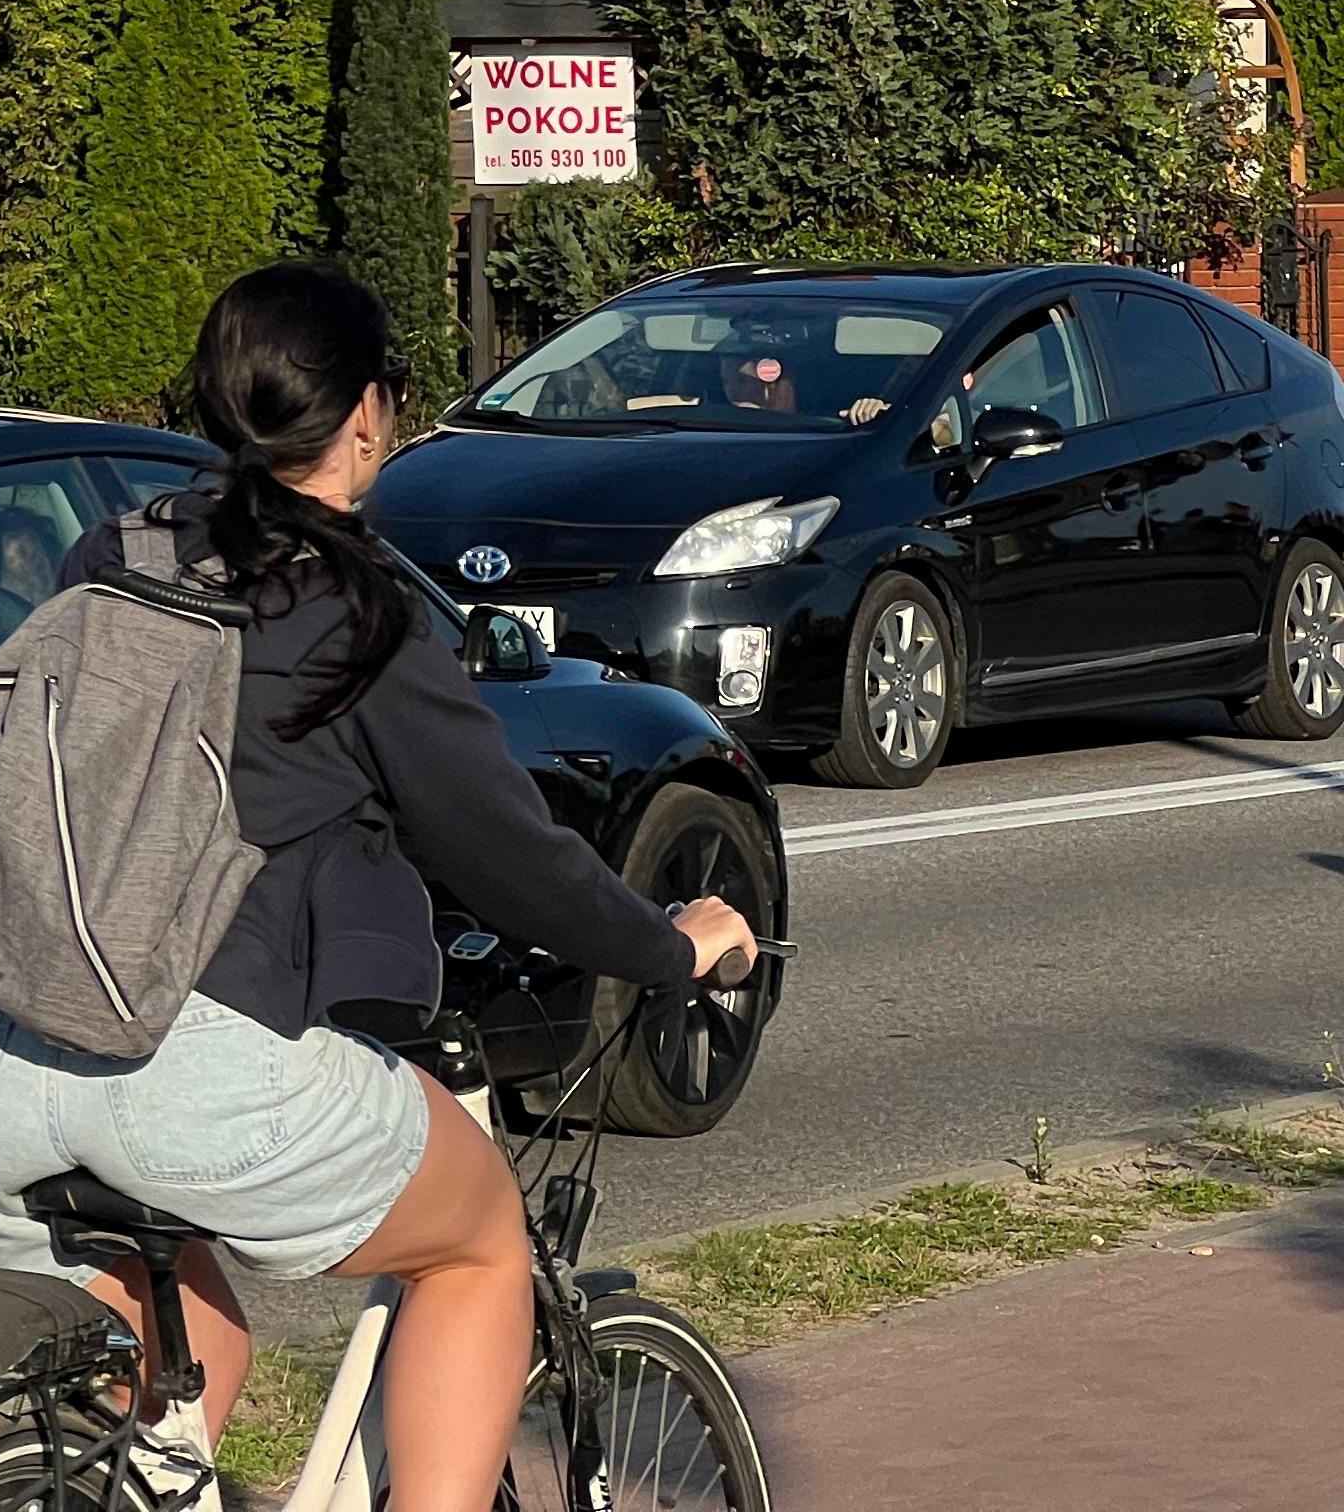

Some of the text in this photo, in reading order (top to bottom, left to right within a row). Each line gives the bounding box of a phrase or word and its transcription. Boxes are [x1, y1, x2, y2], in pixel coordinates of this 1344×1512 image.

[483, 60, 617, 89] WOLNE
[485, 106, 624, 134] POKOJE
[485, 149, 626, 168] tel. 505 930 100
